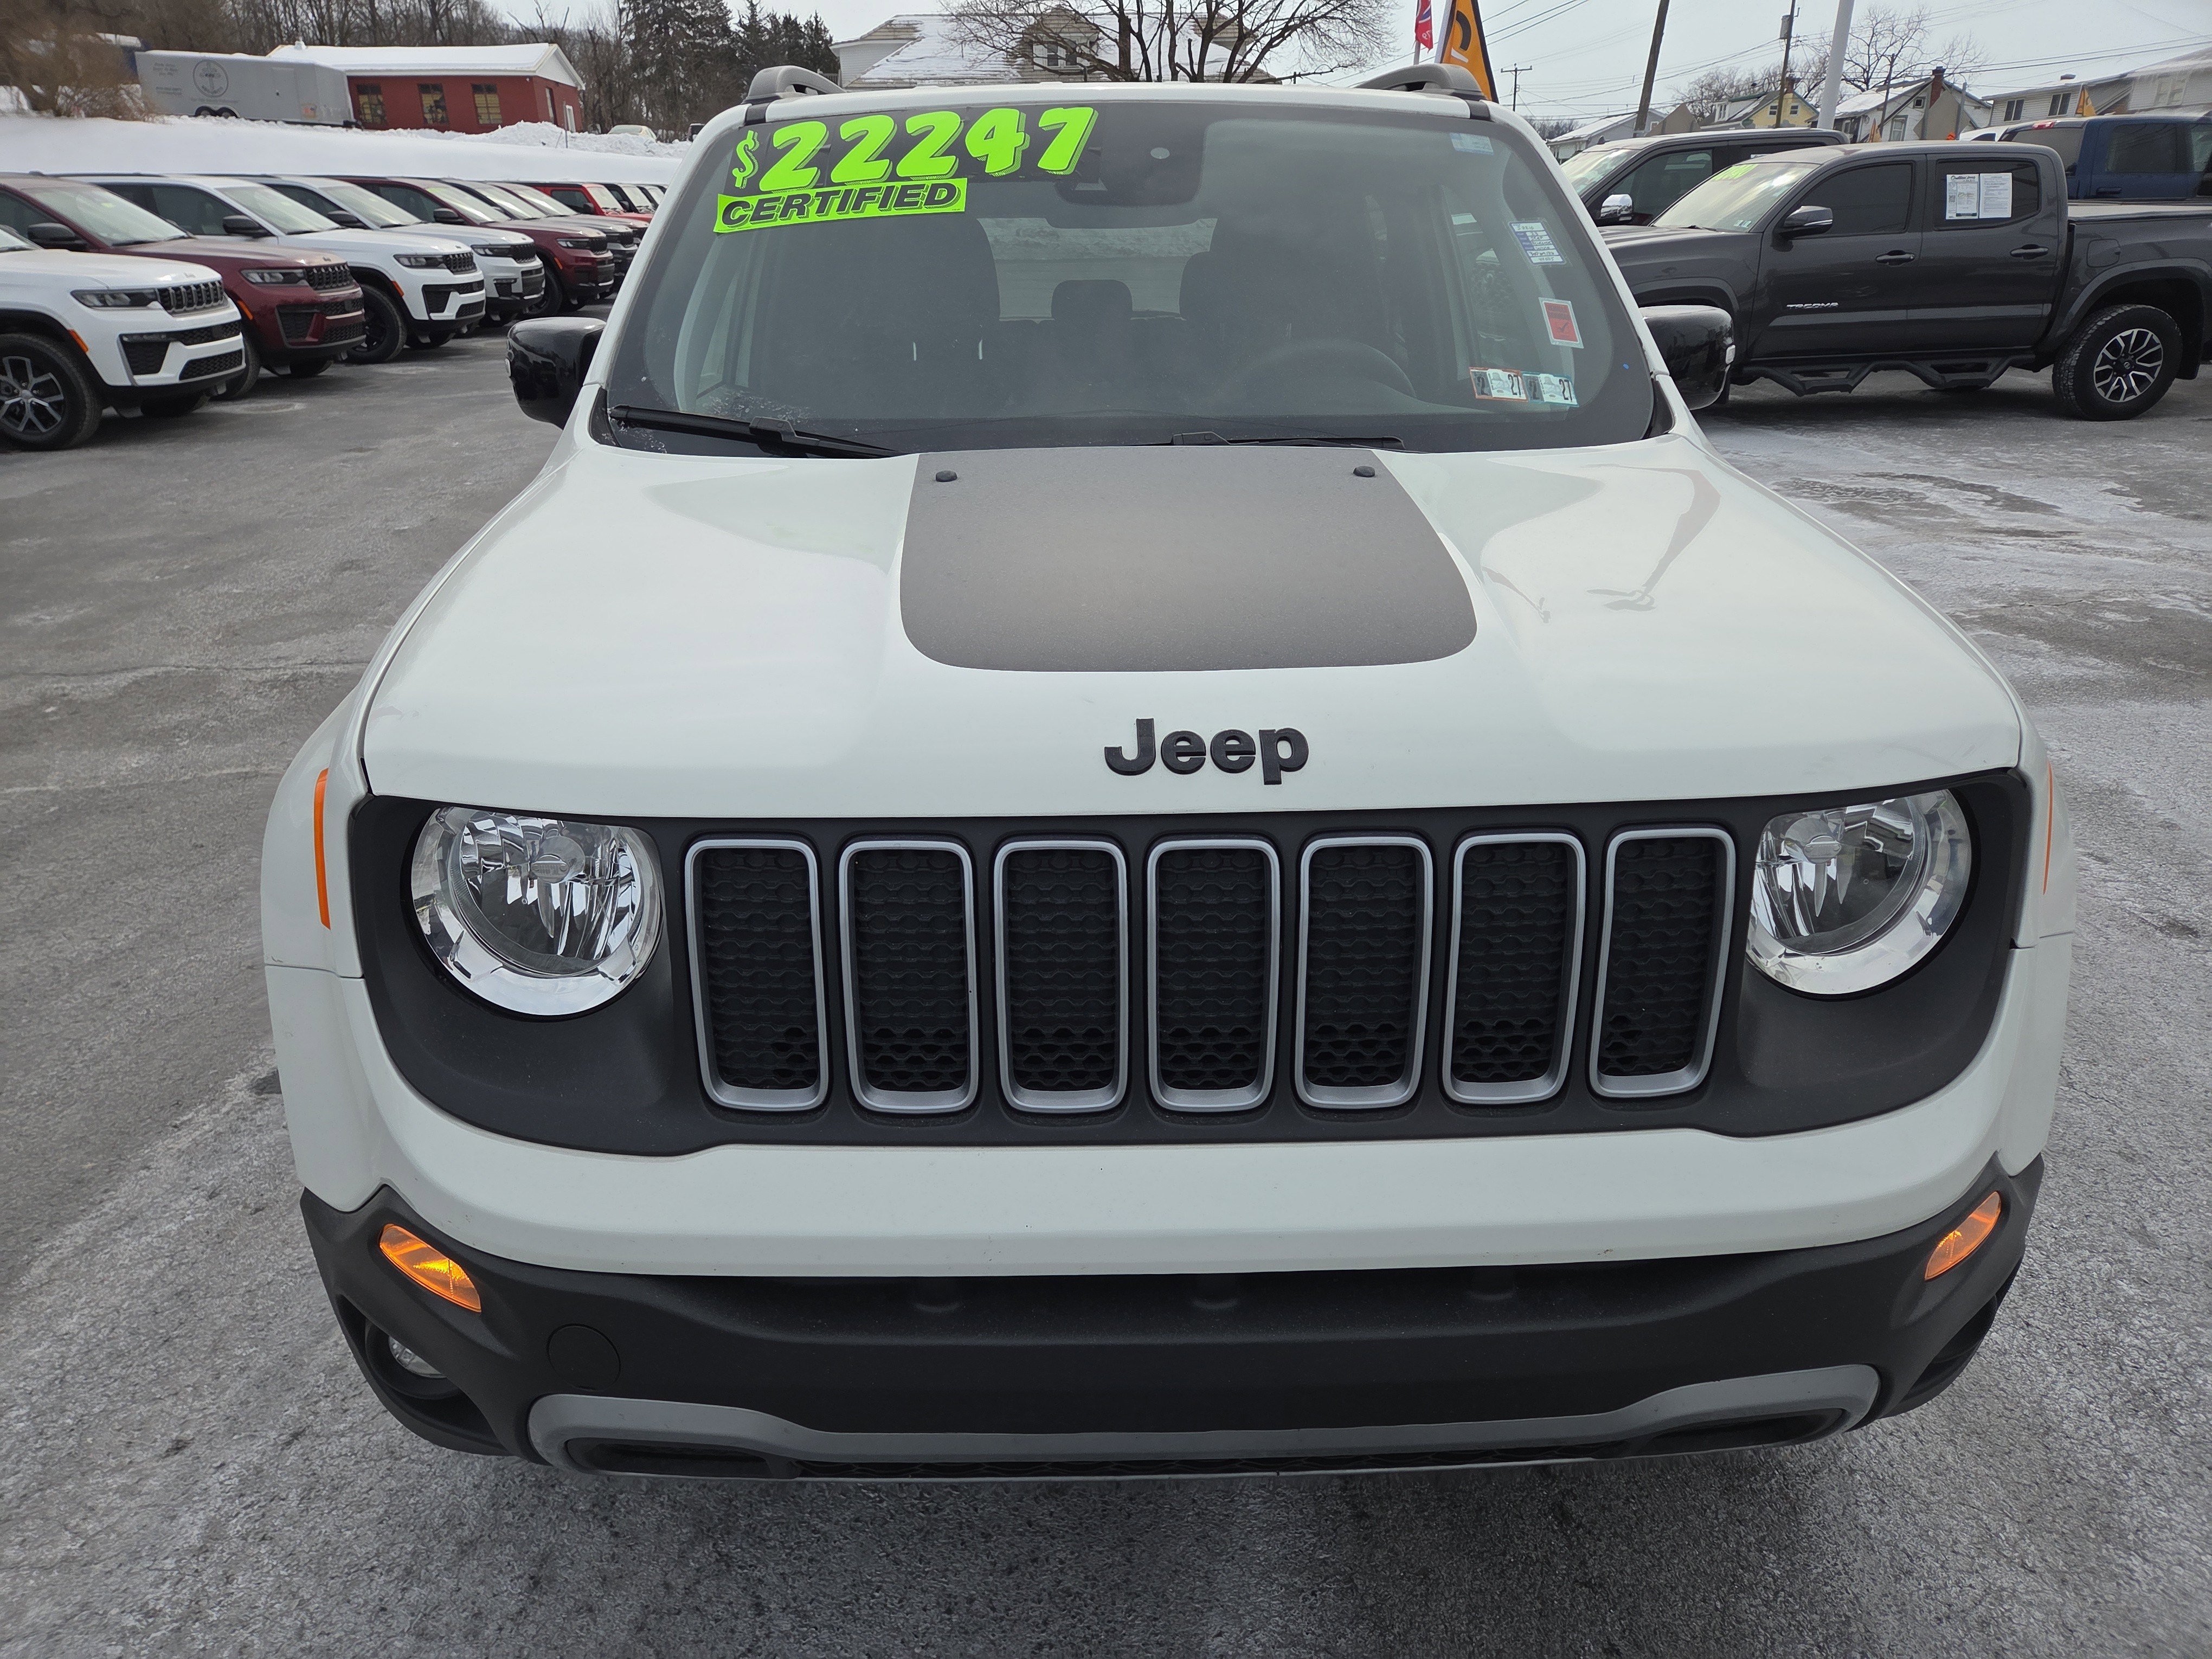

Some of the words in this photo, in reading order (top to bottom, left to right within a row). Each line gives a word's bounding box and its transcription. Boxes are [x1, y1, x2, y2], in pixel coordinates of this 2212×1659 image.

[732, 107, 1098, 193] $22247
[722, 182, 963, 227] CERTIFIED
[1507, 374, 1521, 397] 27
[1559, 378, 1573, 402] 27
[1104, 718, 1309, 785] Jeep
